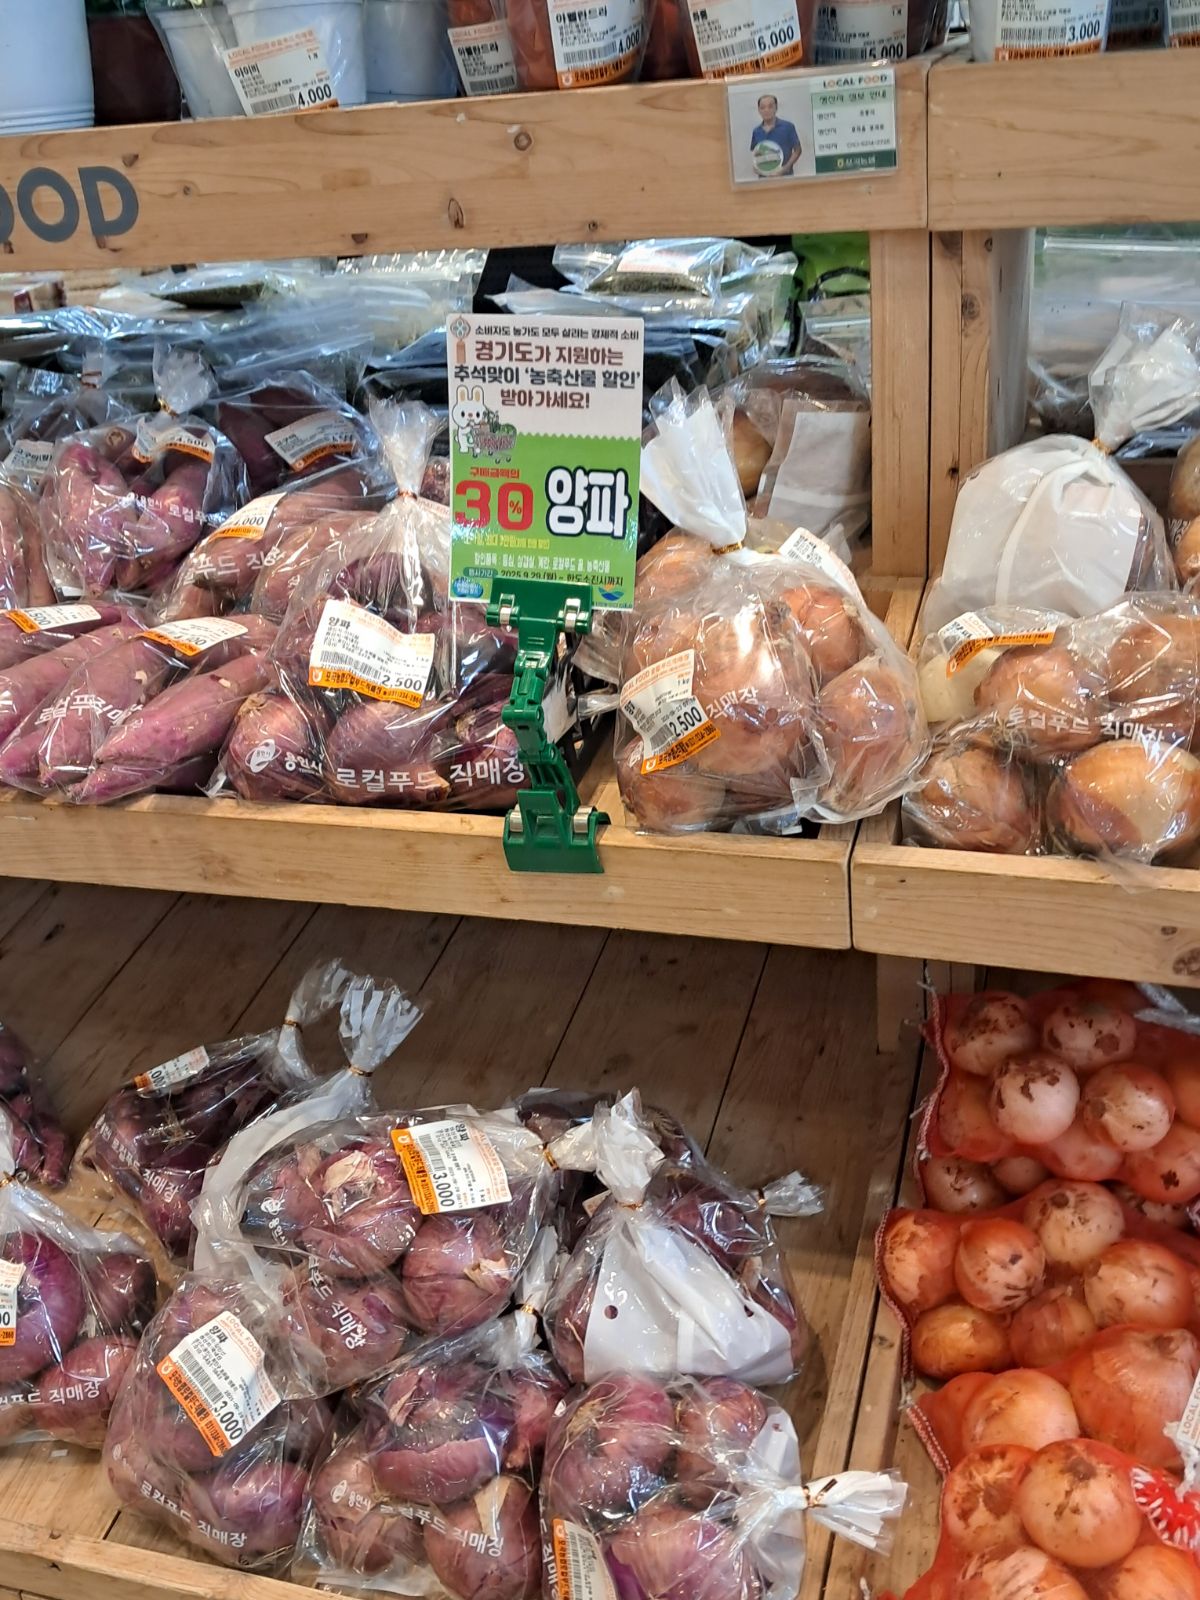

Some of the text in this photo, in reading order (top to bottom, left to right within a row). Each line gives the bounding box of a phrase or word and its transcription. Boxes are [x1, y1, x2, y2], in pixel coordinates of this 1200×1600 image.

[618, 29, 641, 54] 4,000
[756, 25, 795, 51] 6,000
[1067, 20, 1100, 42] 3,000
[234, 62, 260, 79] 아이비
[823, 74, 888, 89] LOCAL FOOD
[298, 84, 332, 107] 4,000
[0, 165, 139, 243] OD
[475, 325, 640, 341] 소비자도 농가도 모두 살리는 경제적 소비
[475, 340, 624, 366] 경기도가 지원하는
[454, 365, 519, 386] 추석맞이
[500, 389, 590, 409] 받아가세요!
[545, 465, 632, 541] 양파
[328, 616, 351, 631] 양파
[381, 674, 423, 692] 2,500
[705, 686, 760, 719] 직매장
[669, 706, 703, 738] 2,500
[1006, 704, 1165, 744] 로컬푸드 직매장
[284, 751, 526, 793] 용인시 로컬푸드 직매장
[455, 1122, 470, 1142] 양파
[143, 1168, 179, 1203] 직매장
[432, 1172, 456, 1207] 3,000
[268, 1217, 288, 1247] 용인시
[331, 1299, 368, 1350] 직매장
[208, 1325, 229, 1344] 양파
[50, 1381, 102, 1406] 직매장
[214, 1400, 243, 1440] 3,000
[1183, 1402, 1200, 1435] LOCAL
[140, 1480, 248, 1548] 로컬푸드 직매장
[348, 1490, 372, 1512] 용인시
[452, 1527, 504, 1557] 직매장
